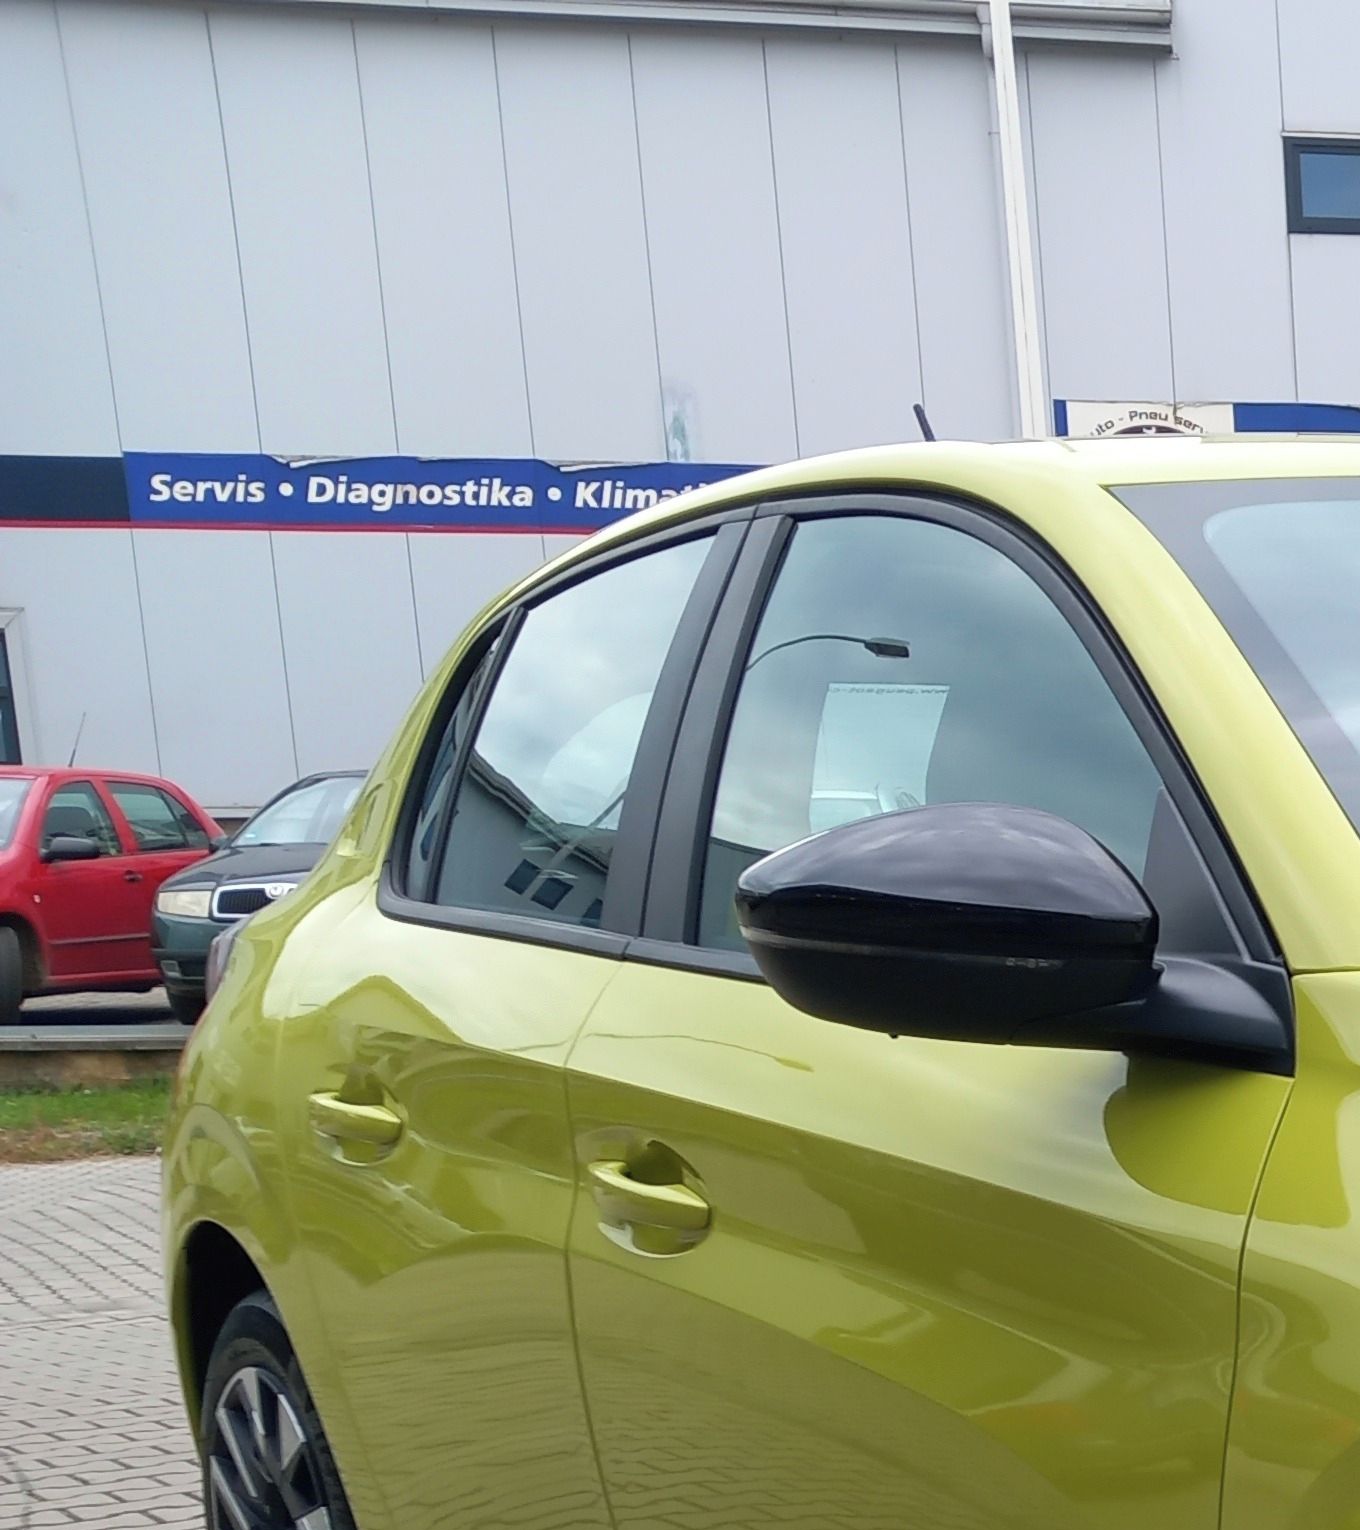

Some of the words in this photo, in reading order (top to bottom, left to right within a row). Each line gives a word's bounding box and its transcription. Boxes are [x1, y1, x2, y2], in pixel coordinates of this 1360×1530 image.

[149, 474, 266, 504] Servis
[307, 475, 533, 511] Diagnostika
[574, 479, 709, 509] Klima
